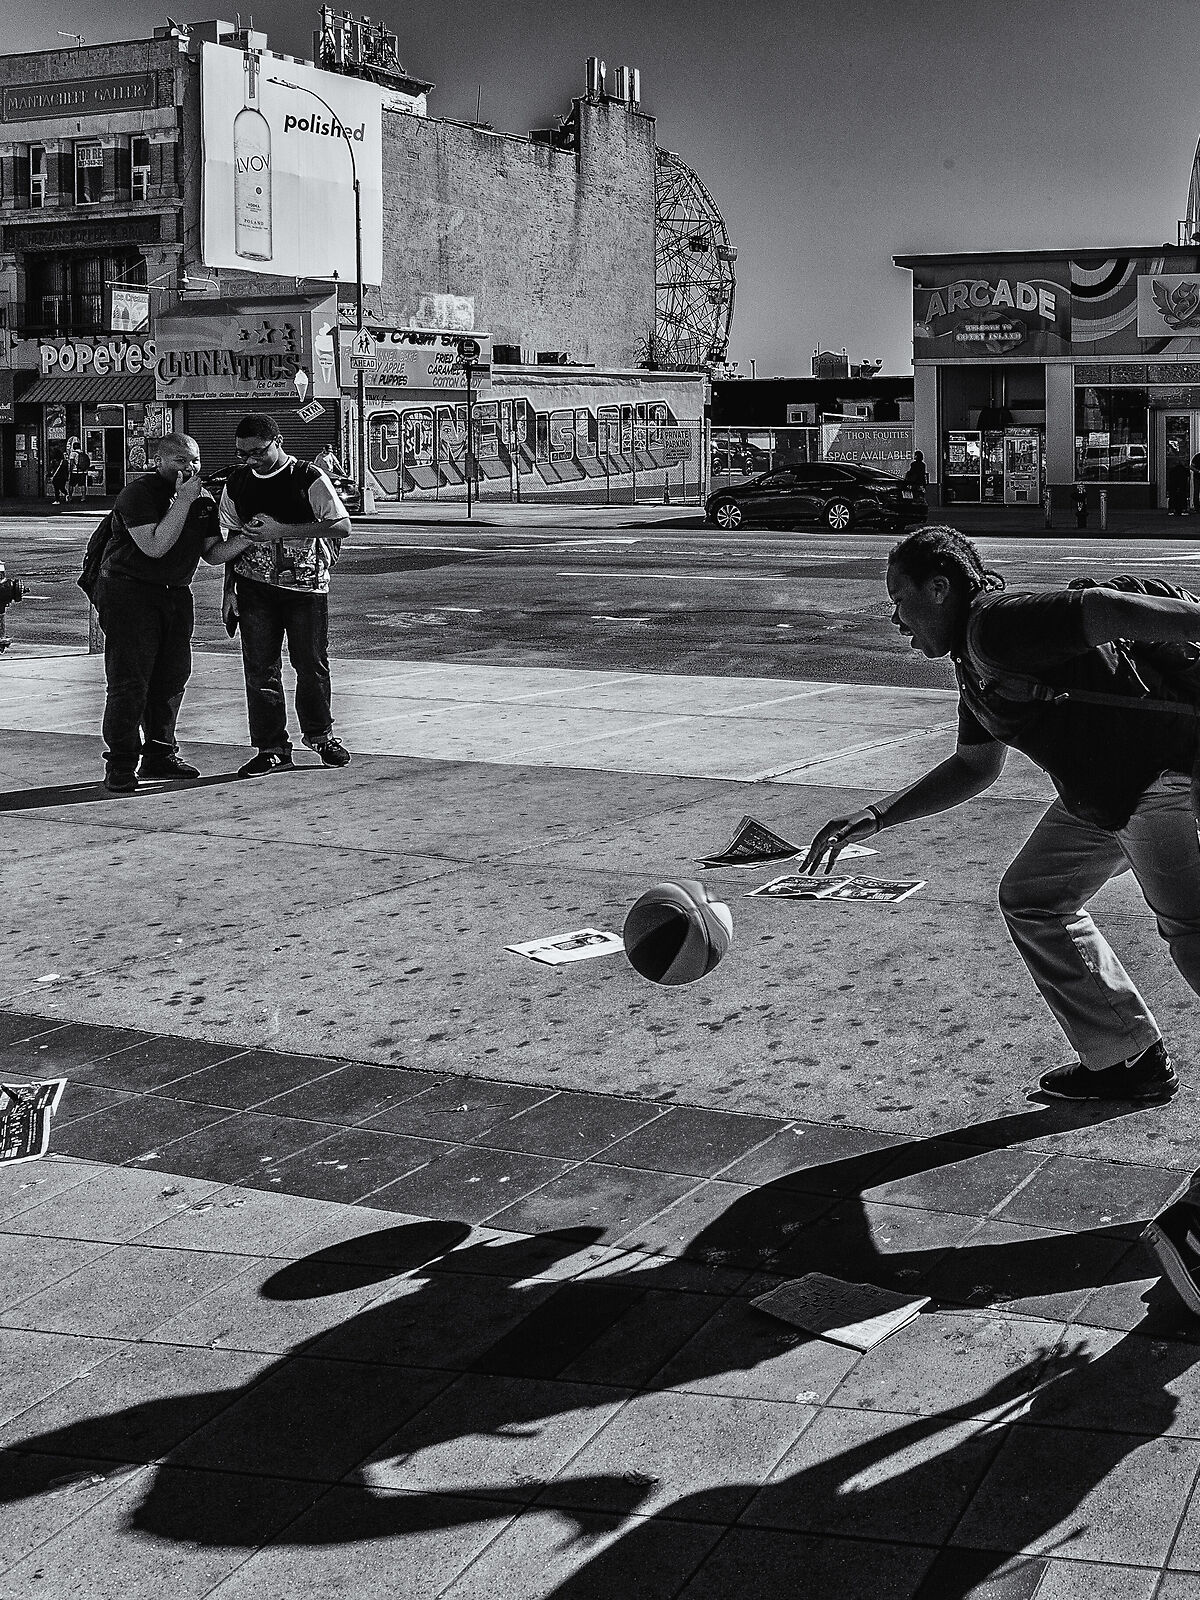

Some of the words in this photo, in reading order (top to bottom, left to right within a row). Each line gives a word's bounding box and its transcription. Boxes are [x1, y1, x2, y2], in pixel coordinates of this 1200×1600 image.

[94, 84, 149, 101] GALLERY
[284, 113, 365, 142] polished
[91, 147, 103, 160] RE
[236, 154, 270, 173] LVOV
[925, 279, 1056, 324] ARCADE
[391, 330, 437, 346] Cream
[988, 332, 1022, 341] ISLAND
[163, 350, 300, 382] LUNATICS
[353, 360, 375, 368] AHEAD
[301, 402, 323, 418] ATM
[367, 397, 531, 474] CONEY
[534, 399, 672, 468] ISLAND
[845, 431, 871, 439] THOR
[873, 431, 909, 439] EQUITIES
[828, 451, 858, 460] SPACE
[860, 450, 912, 460] AVAILABLE
